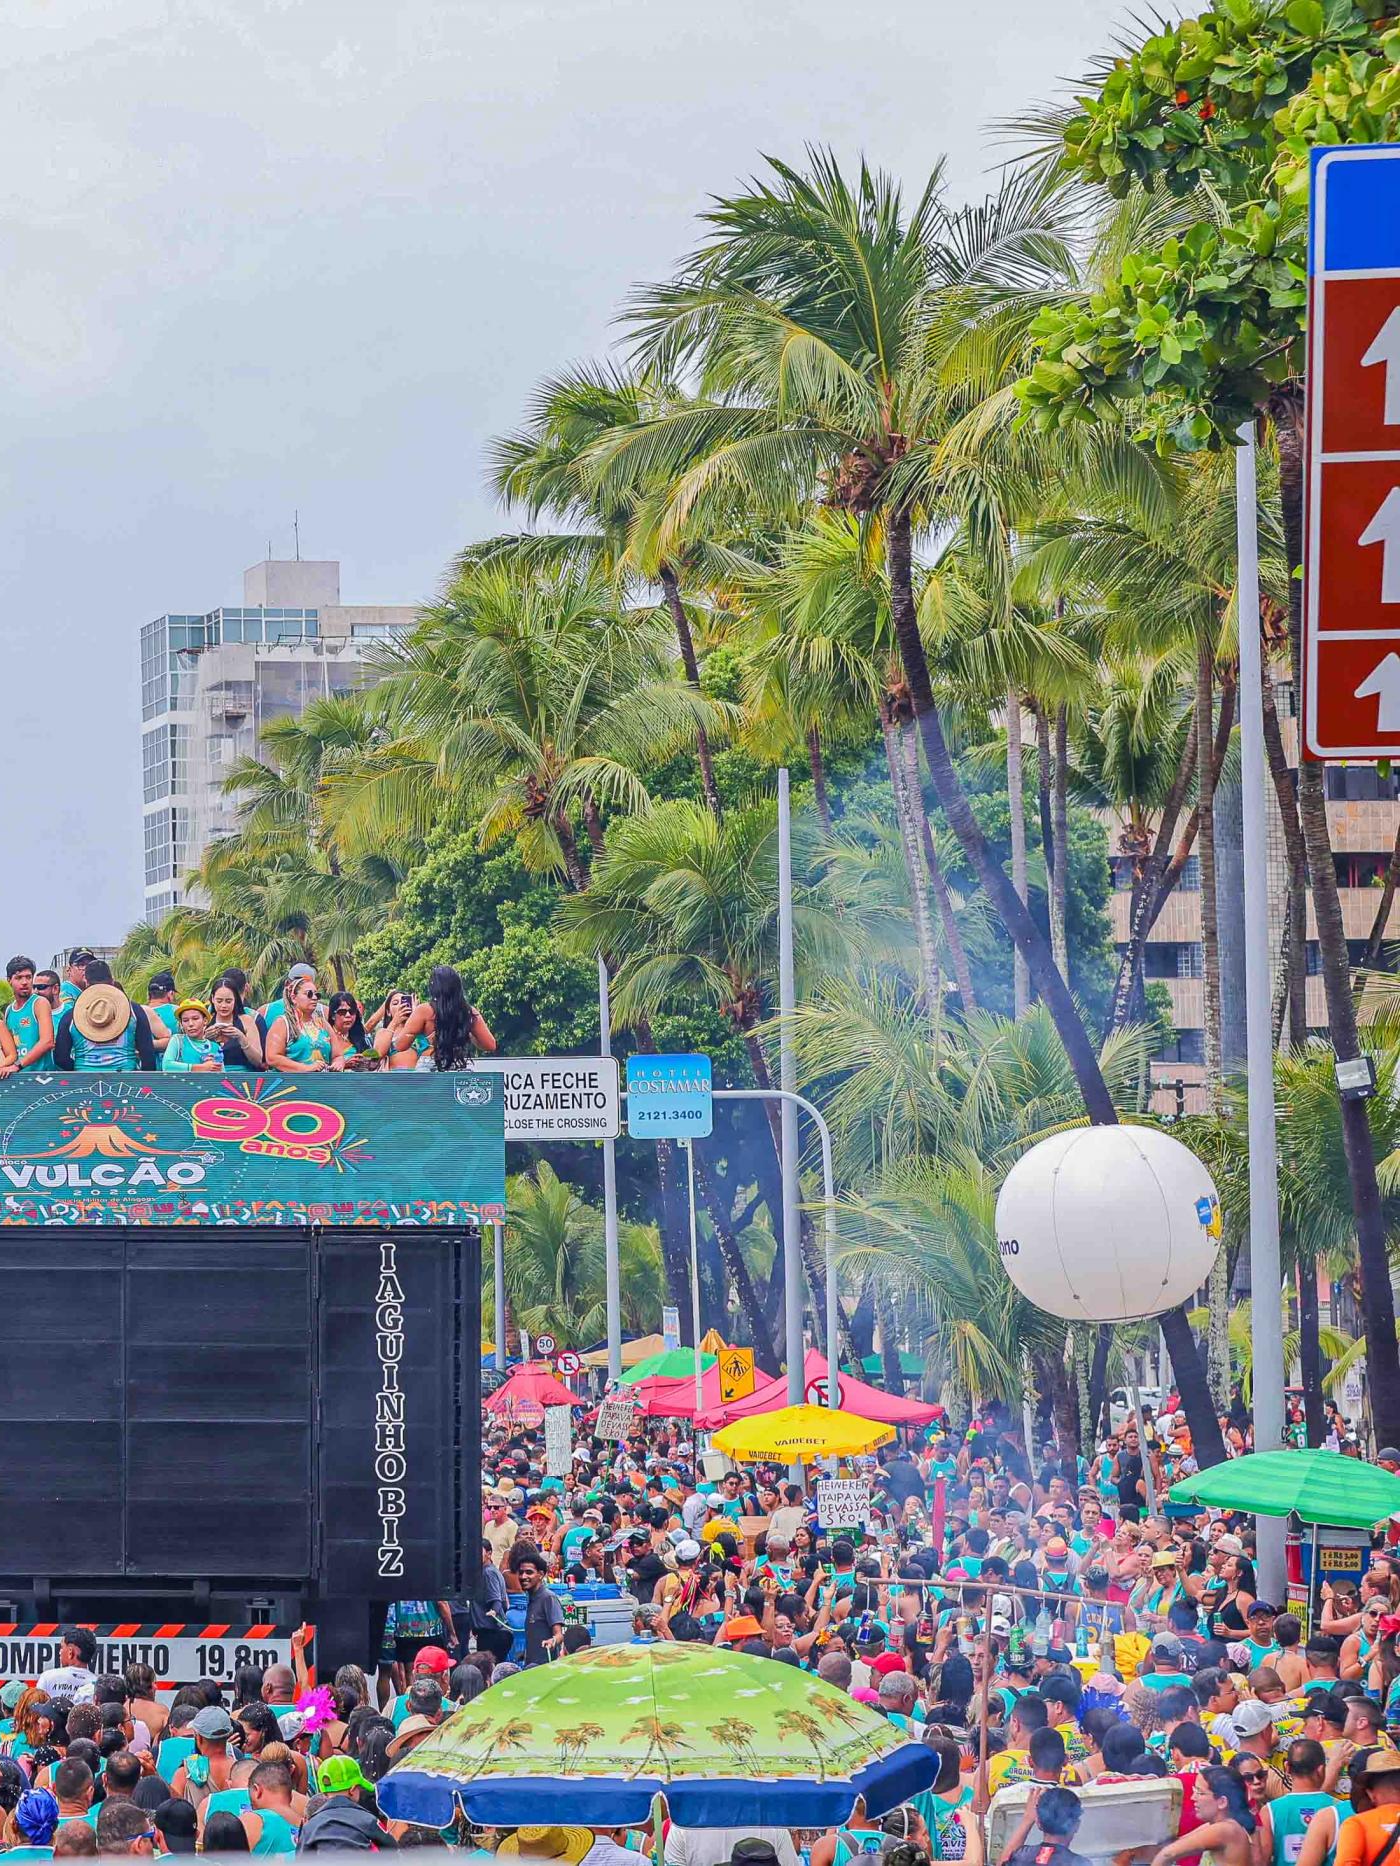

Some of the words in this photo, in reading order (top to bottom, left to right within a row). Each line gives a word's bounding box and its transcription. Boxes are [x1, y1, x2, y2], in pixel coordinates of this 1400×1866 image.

[541, 1072, 599, 1089] FECHE
[628, 1078, 710, 1094] COSTAMAR
[504, 1093, 606, 1110] RUZAMENTO
[191, 1097, 345, 1147] 90
[536, 1118, 554, 1128] THE
[557, 1117, 607, 1128] CROSSING
[638, 1110, 703, 1121] 2121.3400
[240, 1139, 331, 1163] anos
[1, 1156, 205, 1187] VULCÃO
[73, 1188, 137, 1196] 2026
[539, 1339, 553, 1348] 50
[375, 1243, 407, 1482] IAGUINHO
[748, 1450, 782, 1462] VAIDEBET
[819, 1480, 870, 1492] HEINEKEN
[820, 1502, 870, 1514] DEVASSA
[378, 1487, 406, 1577] BIZ
